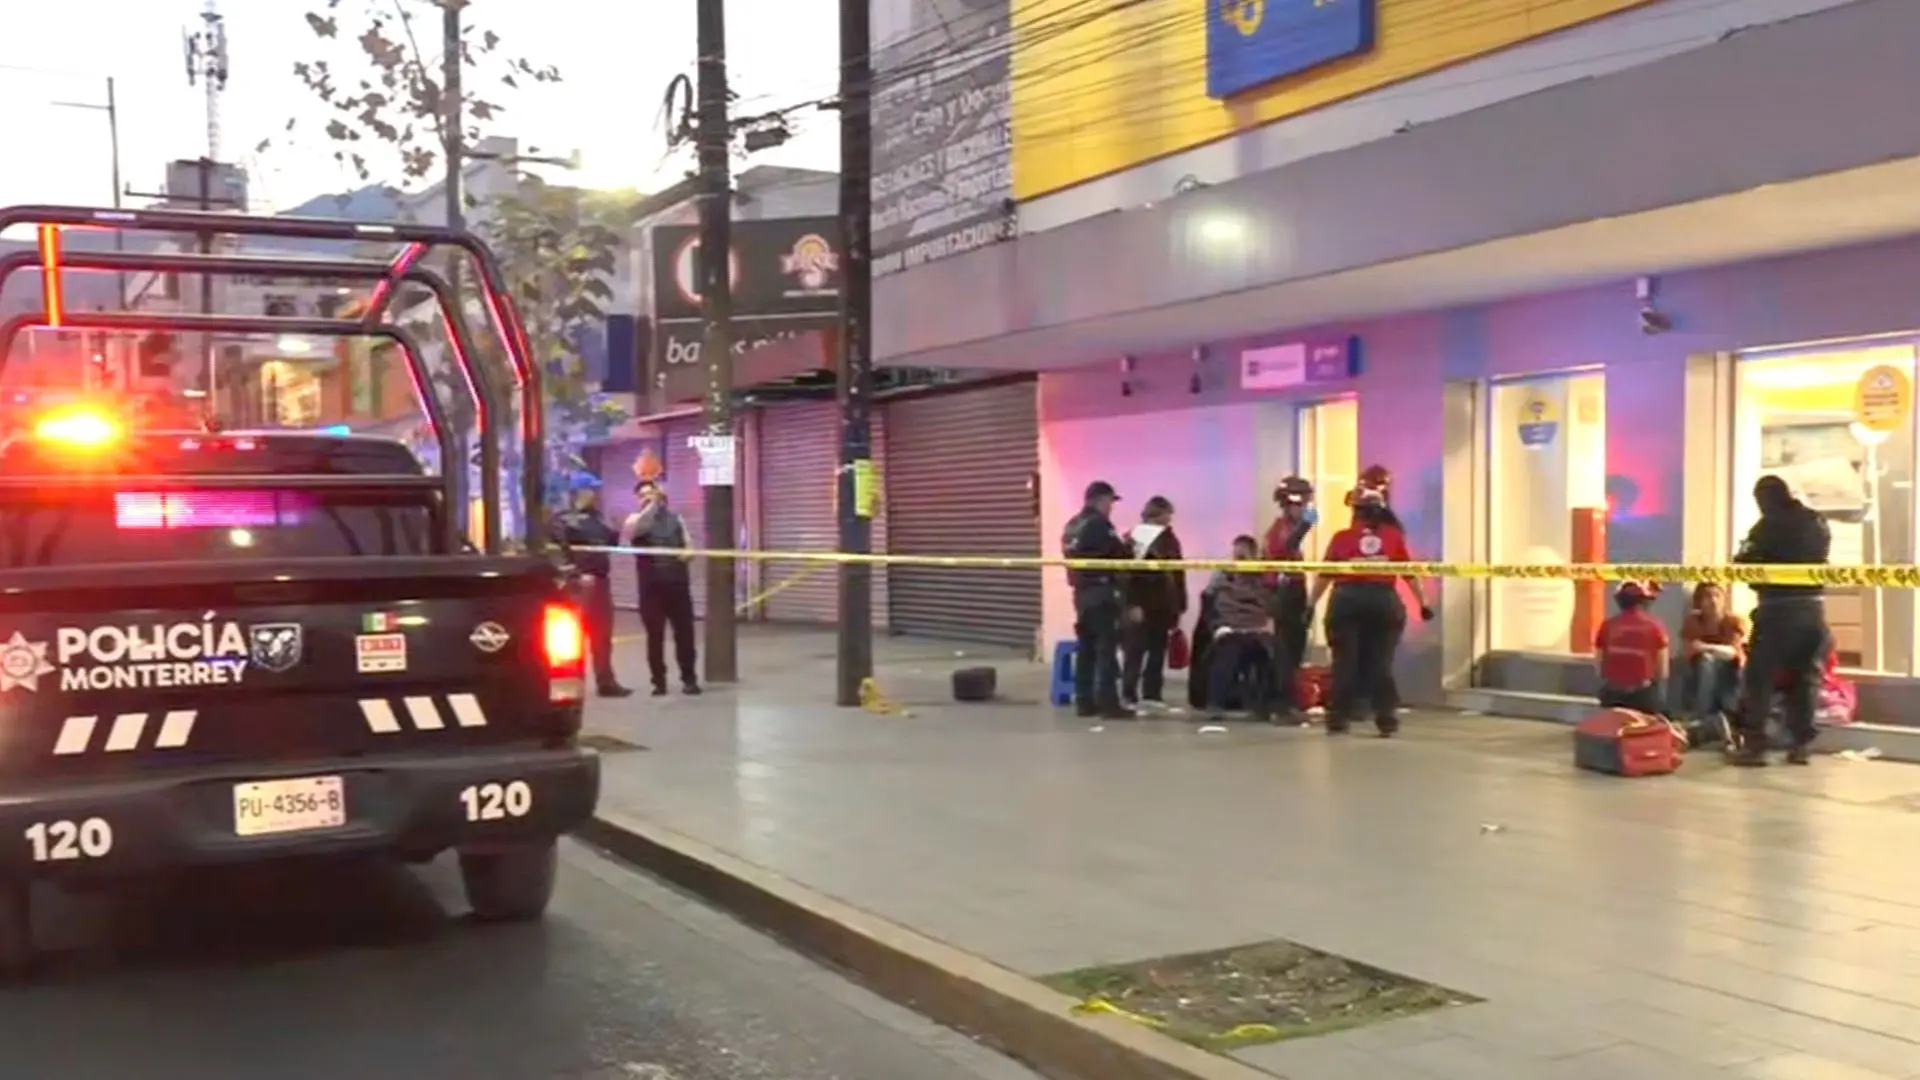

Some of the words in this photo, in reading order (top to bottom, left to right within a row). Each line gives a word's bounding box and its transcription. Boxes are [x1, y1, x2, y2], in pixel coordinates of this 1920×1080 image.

[57, 609, 248, 664] POLICÍA
[60, 659, 249, 691] MONTERREY
[239, 790, 340, 820] PU-4356-B
[460, 780, 532, 822] 120
[24, 816, 113, 862] 120
